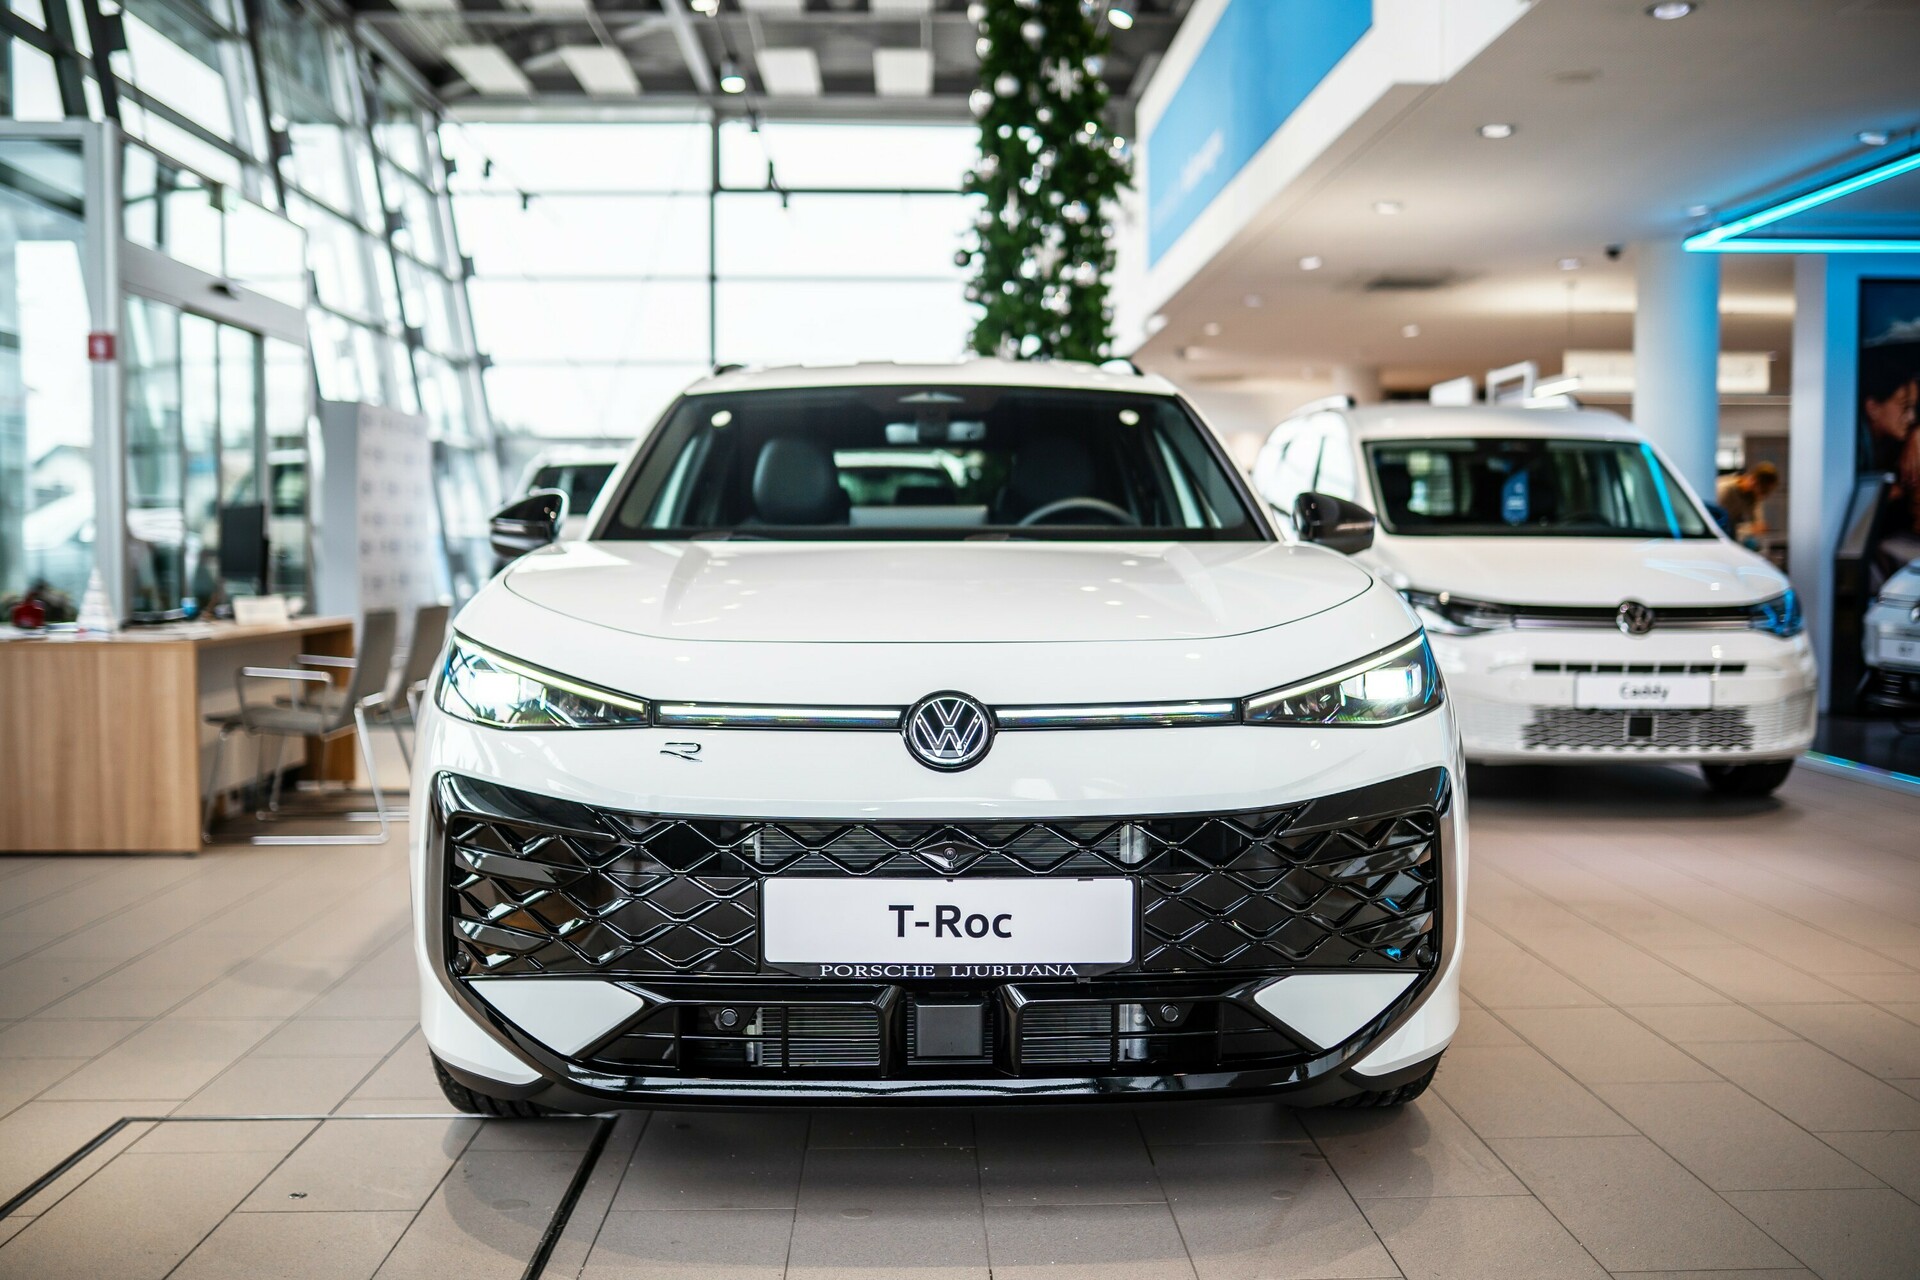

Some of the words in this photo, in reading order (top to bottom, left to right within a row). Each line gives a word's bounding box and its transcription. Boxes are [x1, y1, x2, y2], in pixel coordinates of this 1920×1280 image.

[912, 697, 986, 763] VW
[888, 904, 1013, 939] T-Roc
[819, 964, 936, 978] PORSCHE
[950, 964, 1079, 978] LJUBLJANA
